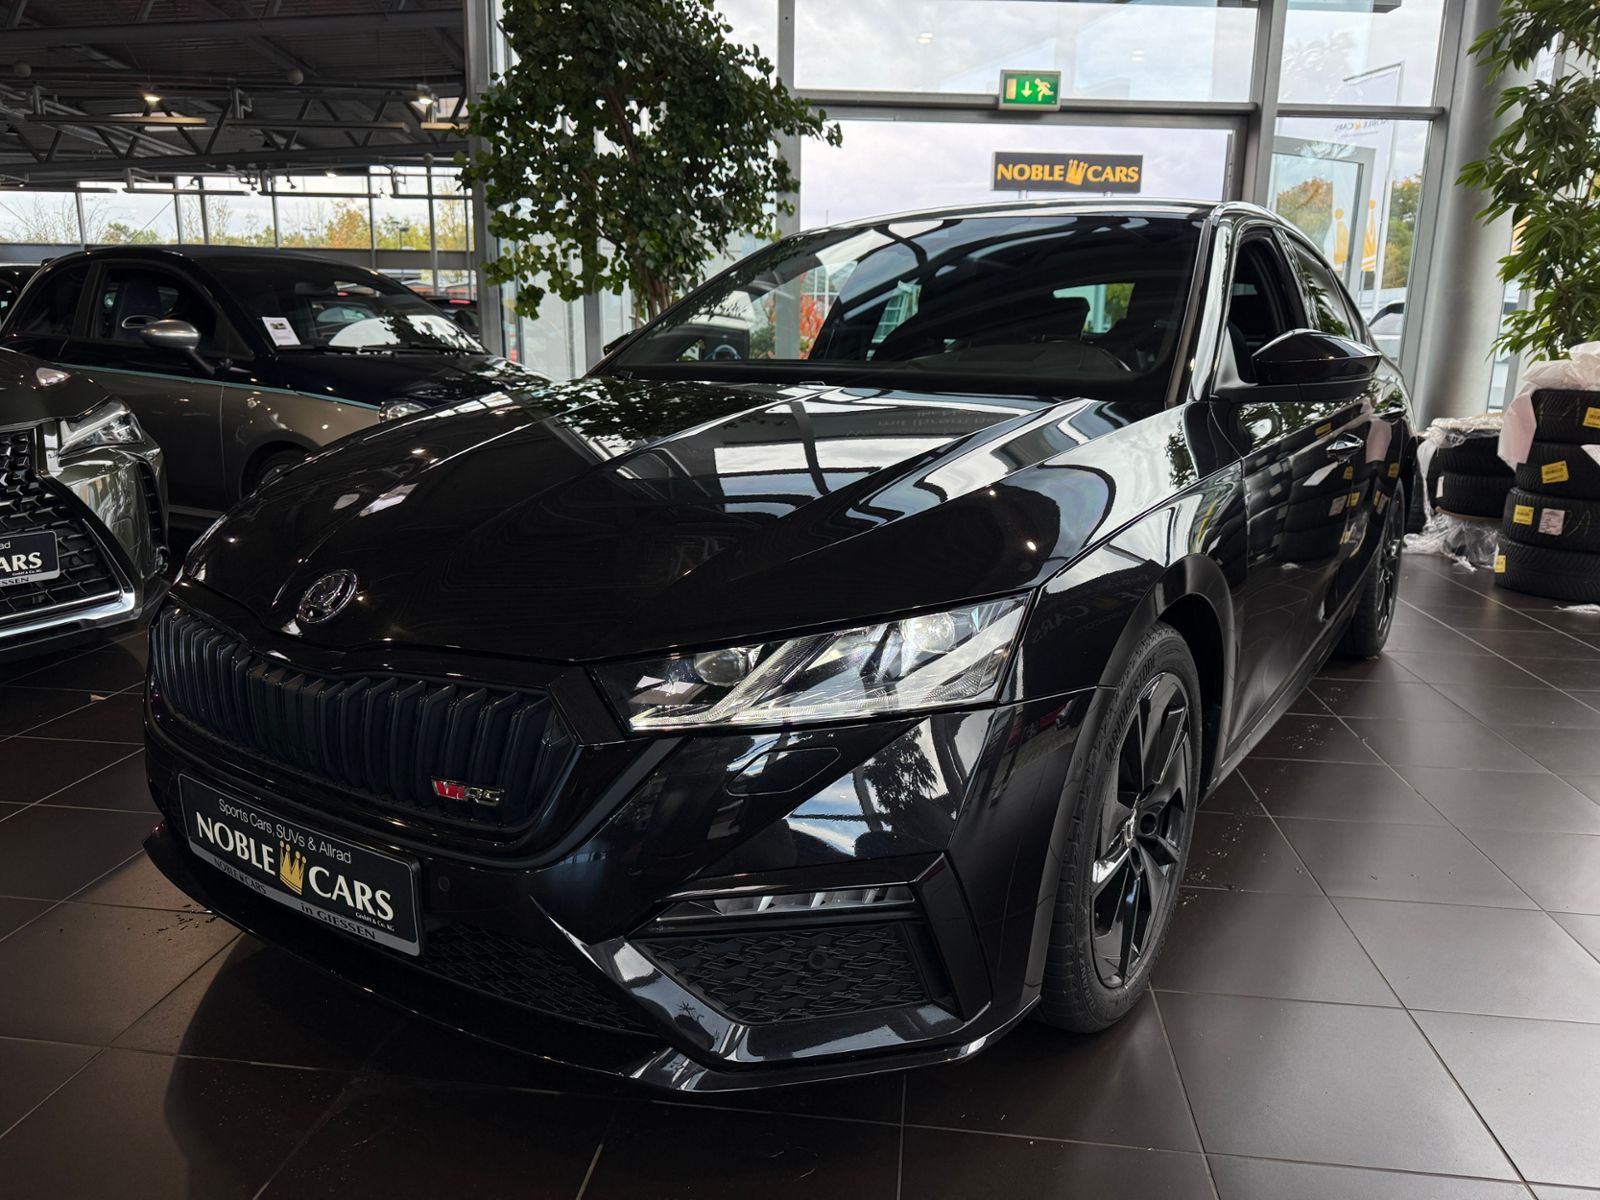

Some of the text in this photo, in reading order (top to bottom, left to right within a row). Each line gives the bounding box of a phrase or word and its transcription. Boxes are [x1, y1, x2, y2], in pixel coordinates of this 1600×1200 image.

[997, 163, 1139, 182] NOBLE CARS
[219, 799, 352, 864] Sports Cars, SUVs & Allrad
[196, 811, 394, 921] NOBLE CARS
[300, 902, 376, 940] in GIESSEN
